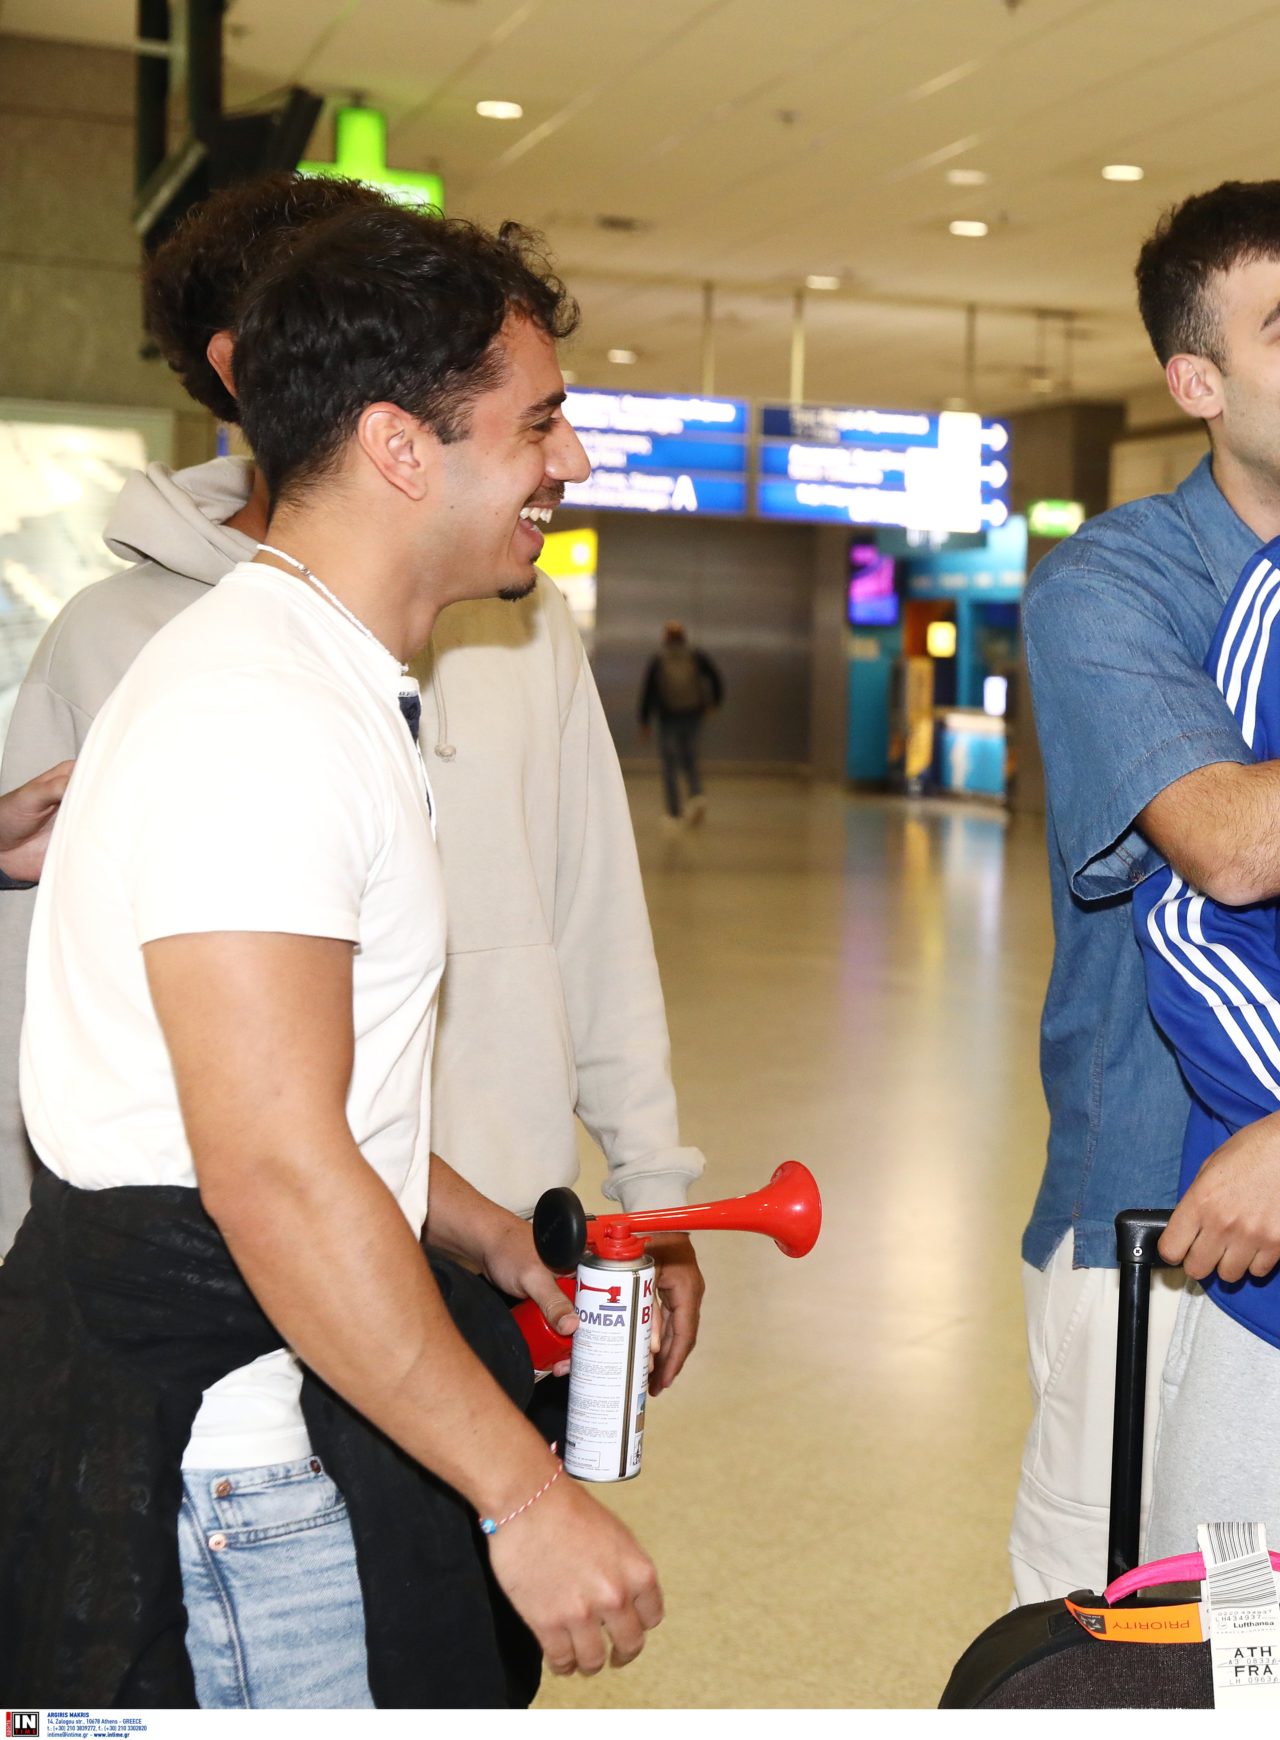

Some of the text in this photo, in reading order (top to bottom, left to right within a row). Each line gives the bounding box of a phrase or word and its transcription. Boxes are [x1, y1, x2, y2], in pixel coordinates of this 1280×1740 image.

[1112, 1620, 1190, 1631] PRIORITY
[1234, 1646, 1272, 1658] ATH
[1234, 1664, 1273, 1677] FRA
